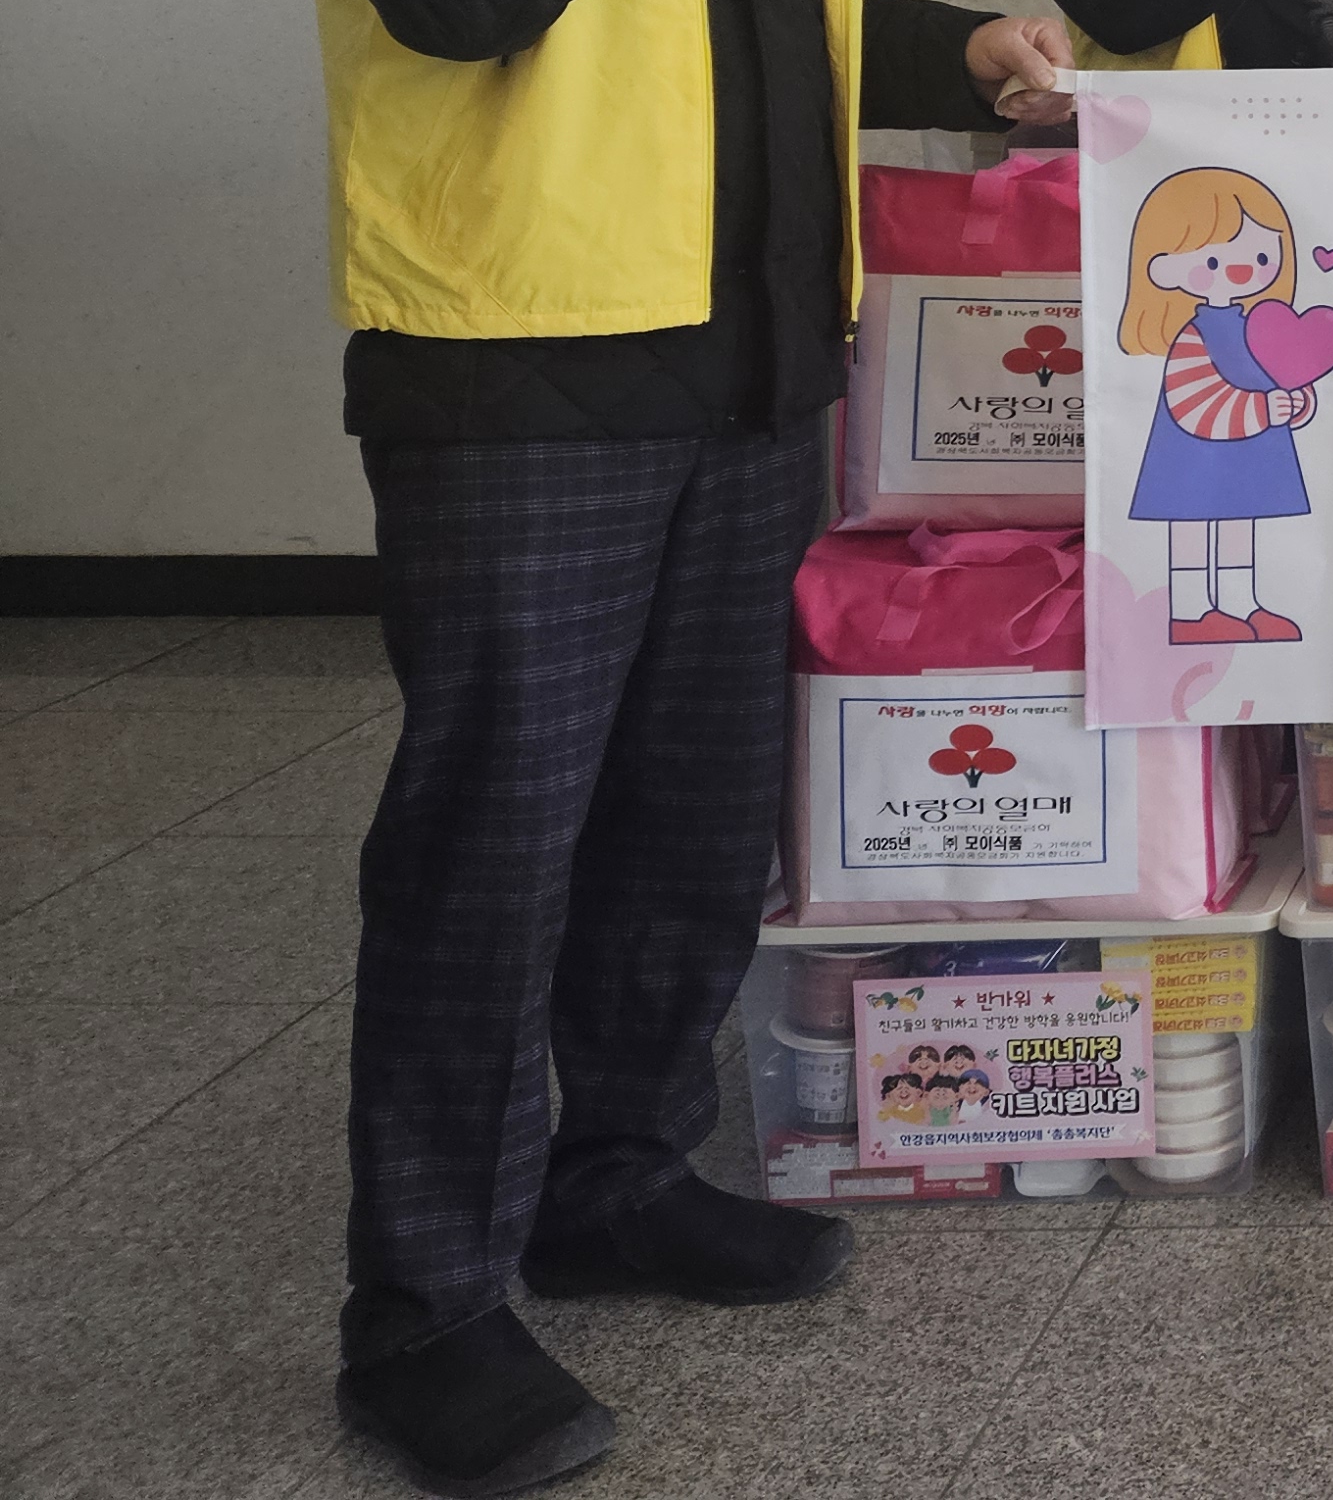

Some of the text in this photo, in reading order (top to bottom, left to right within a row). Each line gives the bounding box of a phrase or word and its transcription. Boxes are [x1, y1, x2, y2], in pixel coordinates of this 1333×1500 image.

[947, 393, 1054, 421] 사랑의
[934, 431, 980, 446] 2025년
[876, 796, 1072, 823] 사랑의 열매
[864, 836, 1022, 850] 2025년 모이식품
[1156, 974, 1207, 988] 쇠고기짜장
[975, 990, 1030, 1012] 반가워
[879, 1011, 1129, 1033] 친구들의 활기차고 건강한 방학을 응원합니다!
[1007, 1036, 1121, 1064] 다자녀가정
[1009, 1062, 1122, 1089] 행복플러스
[992, 1088, 1139, 1117] 키트 지원 사업
